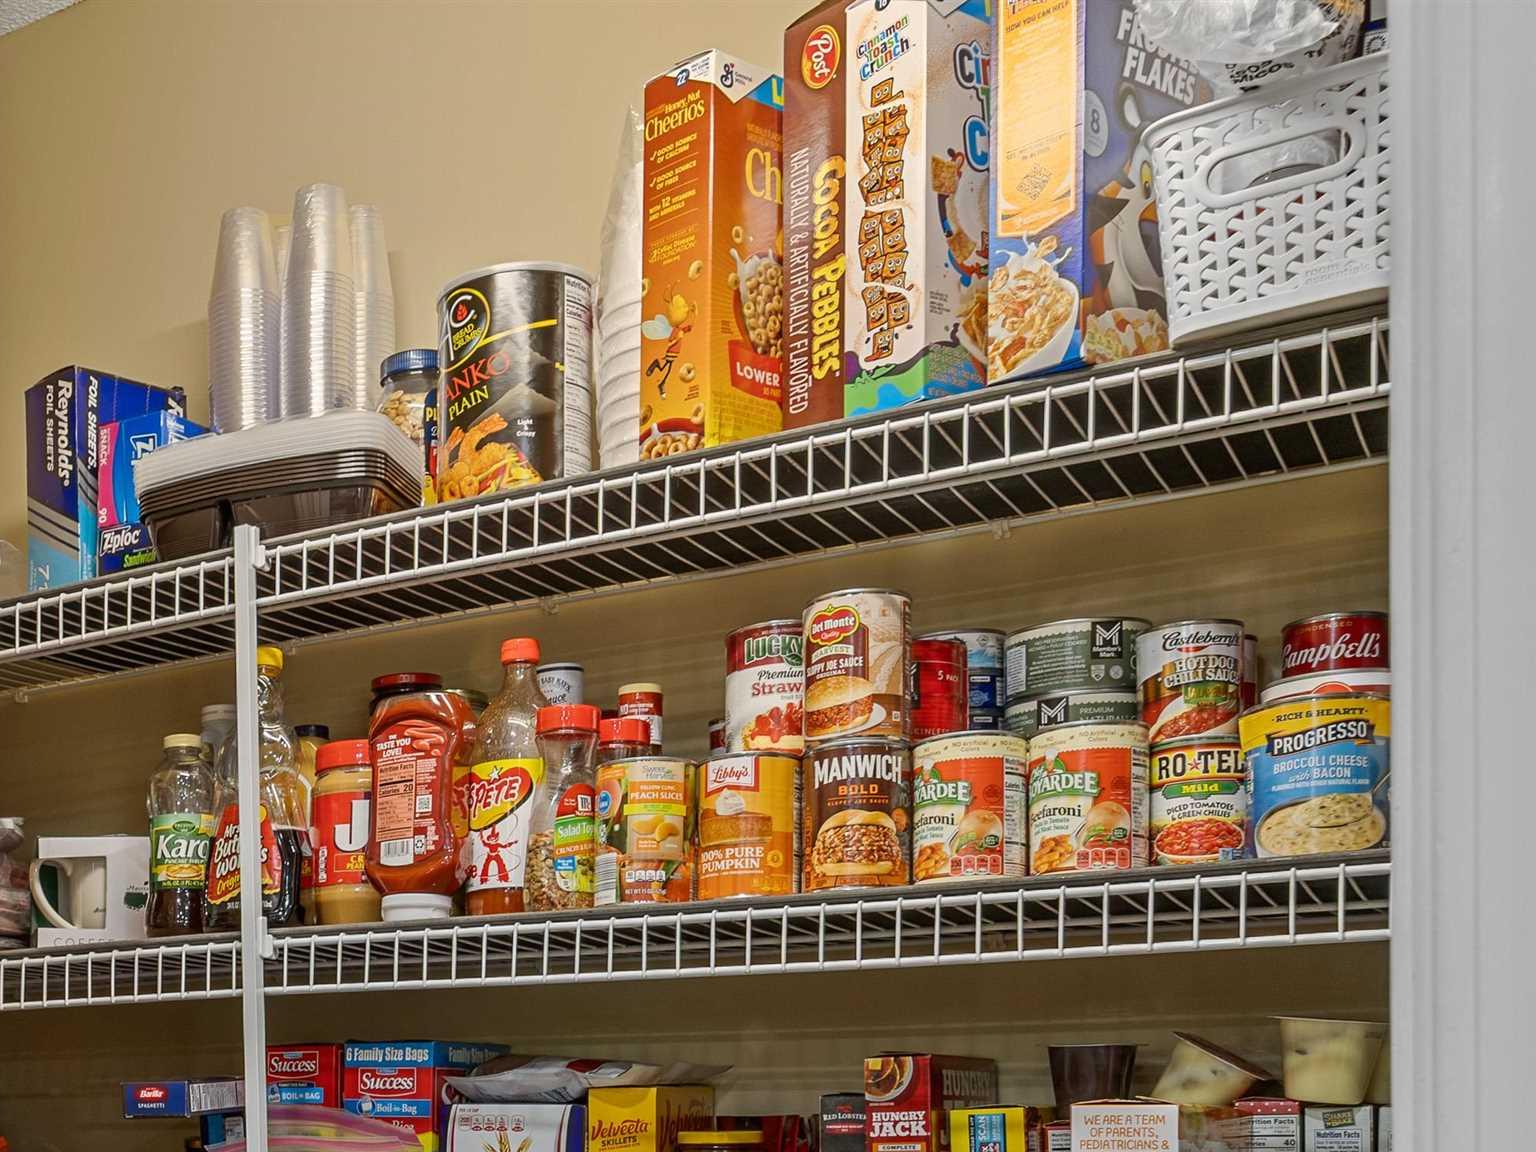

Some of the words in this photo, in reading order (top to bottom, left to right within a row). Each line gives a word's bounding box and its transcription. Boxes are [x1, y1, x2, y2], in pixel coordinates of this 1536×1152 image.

[807, 33, 831, 80] Post
[1122, 46, 1197, 105] FLAKES
[644, 100, 705, 143] Cheerios
[1090, 107, 1100, 134] 8
[789, 147, 810, 231] NATURALLY
[813, 156, 846, 259] COCOA
[789, 247, 809, 329] ARTIFICIALLY
[812, 255, 845, 380] PEBBLES
[736, 361, 781, 387] LOWER
[789, 330, 811, 415] FLAVORED
[45, 384, 55, 411] FOIL
[448, 384, 491, 422] PLAIN
[54, 379, 75, 480] Reynolds
[44, 411, 55, 473] SHEETS
[98, 428, 110, 467] SNACK
[101, 527, 143, 556] Ziploc
[1282, 632, 1382, 669] Campbell's
[376, 739, 395, 752] TASTE
[395, 737, 411, 749] YOU
[1272, 721, 1368, 754] PROGRESSO
[712, 763, 752, 785] Libby's
[814, 755, 904, 789] MANWICH
[1272, 757, 1327, 774] BROCCOLI
[1328, 755, 1370, 769] CHEESE
[1287, 770, 1312, 783] with
[1312, 767, 1352, 780] BACON
[630, 790, 658, 801] PEACH
[659, 790, 684, 801] SLICES
[837, 784, 879, 796] BOLD
[1181, 782, 1220, 794] Mild
[1166, 804, 1187, 816] DICED
[1187, 801, 1235, 813] TOMATOES
[558, 821, 583, 840] Salad
[701, 848, 724, 862] 100%
[725, 846, 765, 859] PURE
[701, 858, 762, 874] PUMPKIN
[269, 1057, 317, 1073] Success
[346, 1048, 353, 1061] 6
[353, 1047, 383, 1063] Family
[385, 1047, 404, 1061] Size
[404, 1047, 430, 1062] Bags
[360, 1072, 415, 1091] Success
[137, 1101, 166, 1110] SPAGHETTI
[871, 1110, 926, 1123] HUNGRY
[1083, 1114, 1100, 1126] WE
[1100, 1114, 1123, 1126] ARE
[1133, 1114, 1166, 1126] TEAM
[590, 1119, 651, 1143] Velveeta
[869, 1119, 929, 1139] JACK
[1089, 1127, 1104, 1139] OF
[1105, 1127, 1159, 1140] PARENTS,
[600, 1135, 639, 1148] SKILLETS
[880, 1143, 918, 1152] COMPLETE
[1079, 1139, 1160, 1151] PEDIATRICIANS
